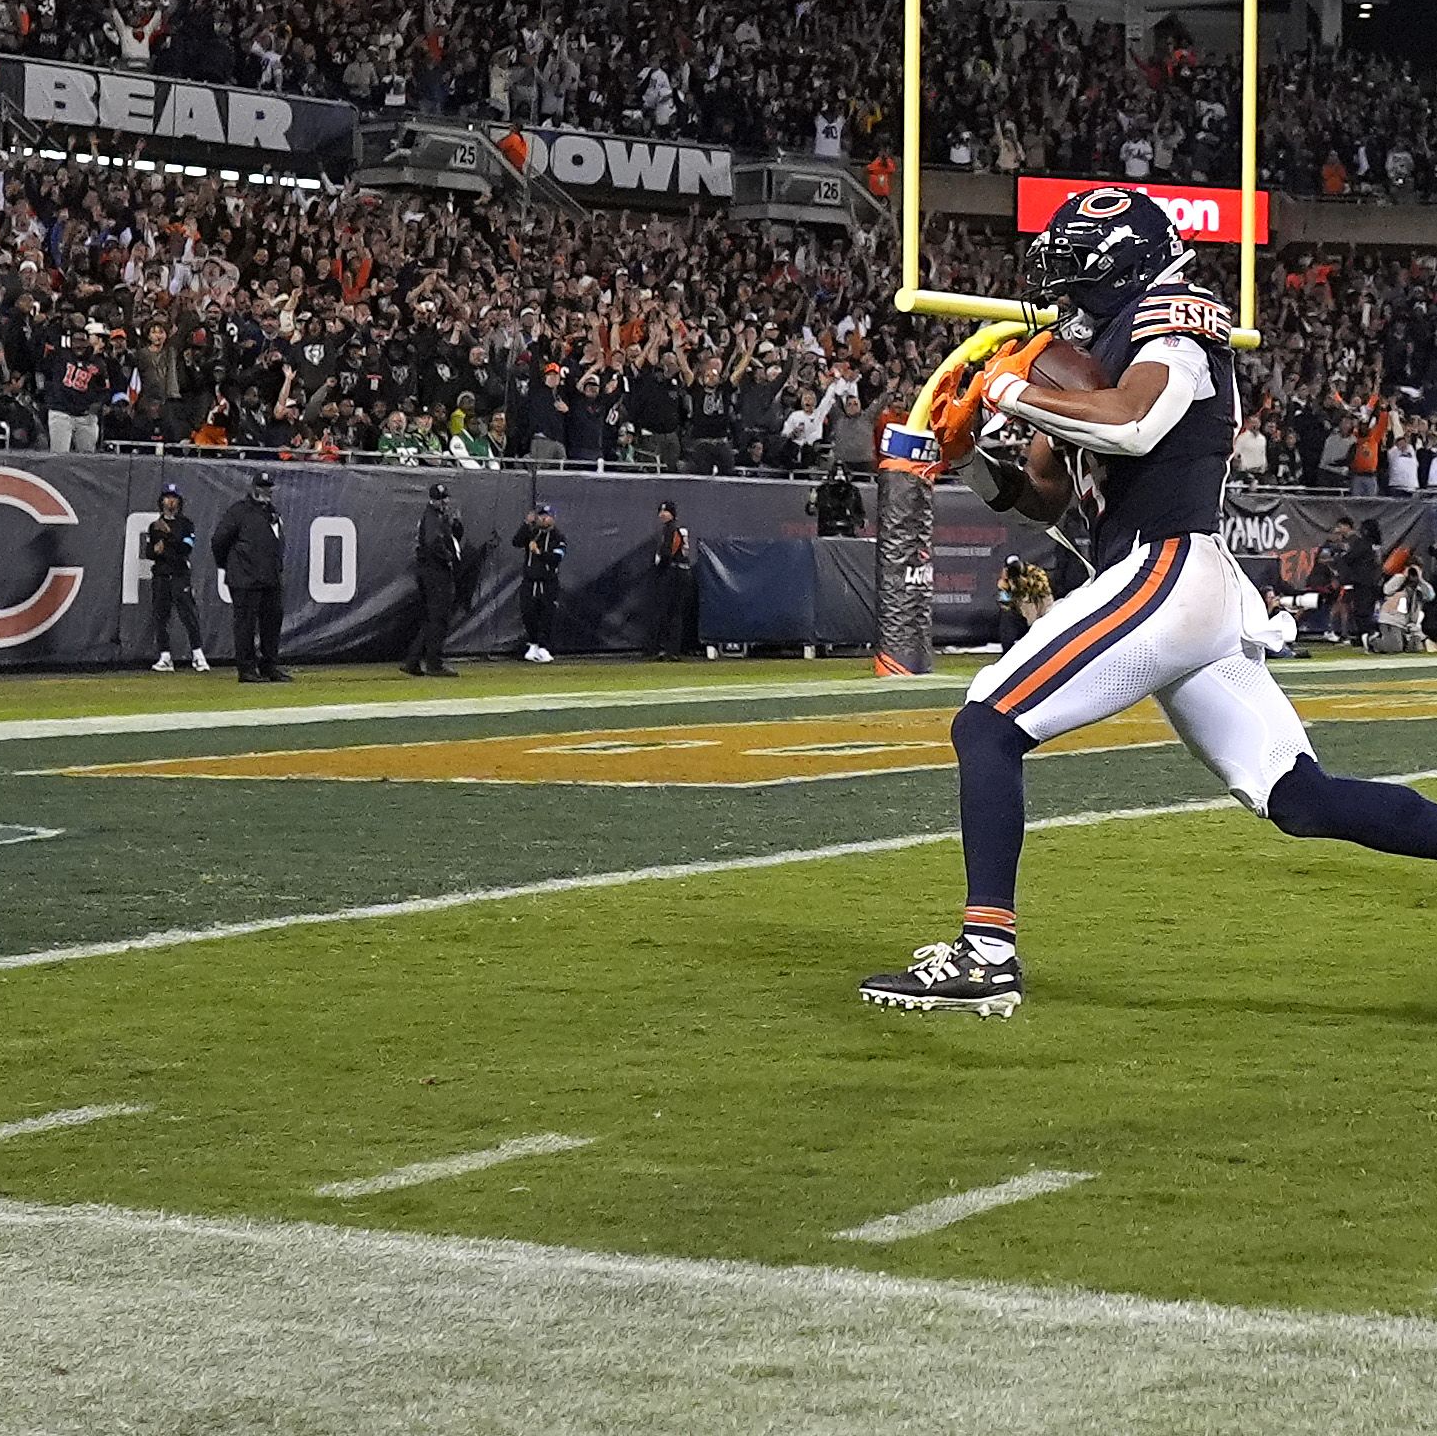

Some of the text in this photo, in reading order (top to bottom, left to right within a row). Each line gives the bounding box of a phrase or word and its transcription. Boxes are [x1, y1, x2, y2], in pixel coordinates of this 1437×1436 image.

[24, 63, 294, 152] BEAR
[453, 144, 477, 168] 125
[817, 178, 840, 201] 126
[1168, 301, 1219, 333] GSH
[1219, 514, 1290, 552] VAMOS
